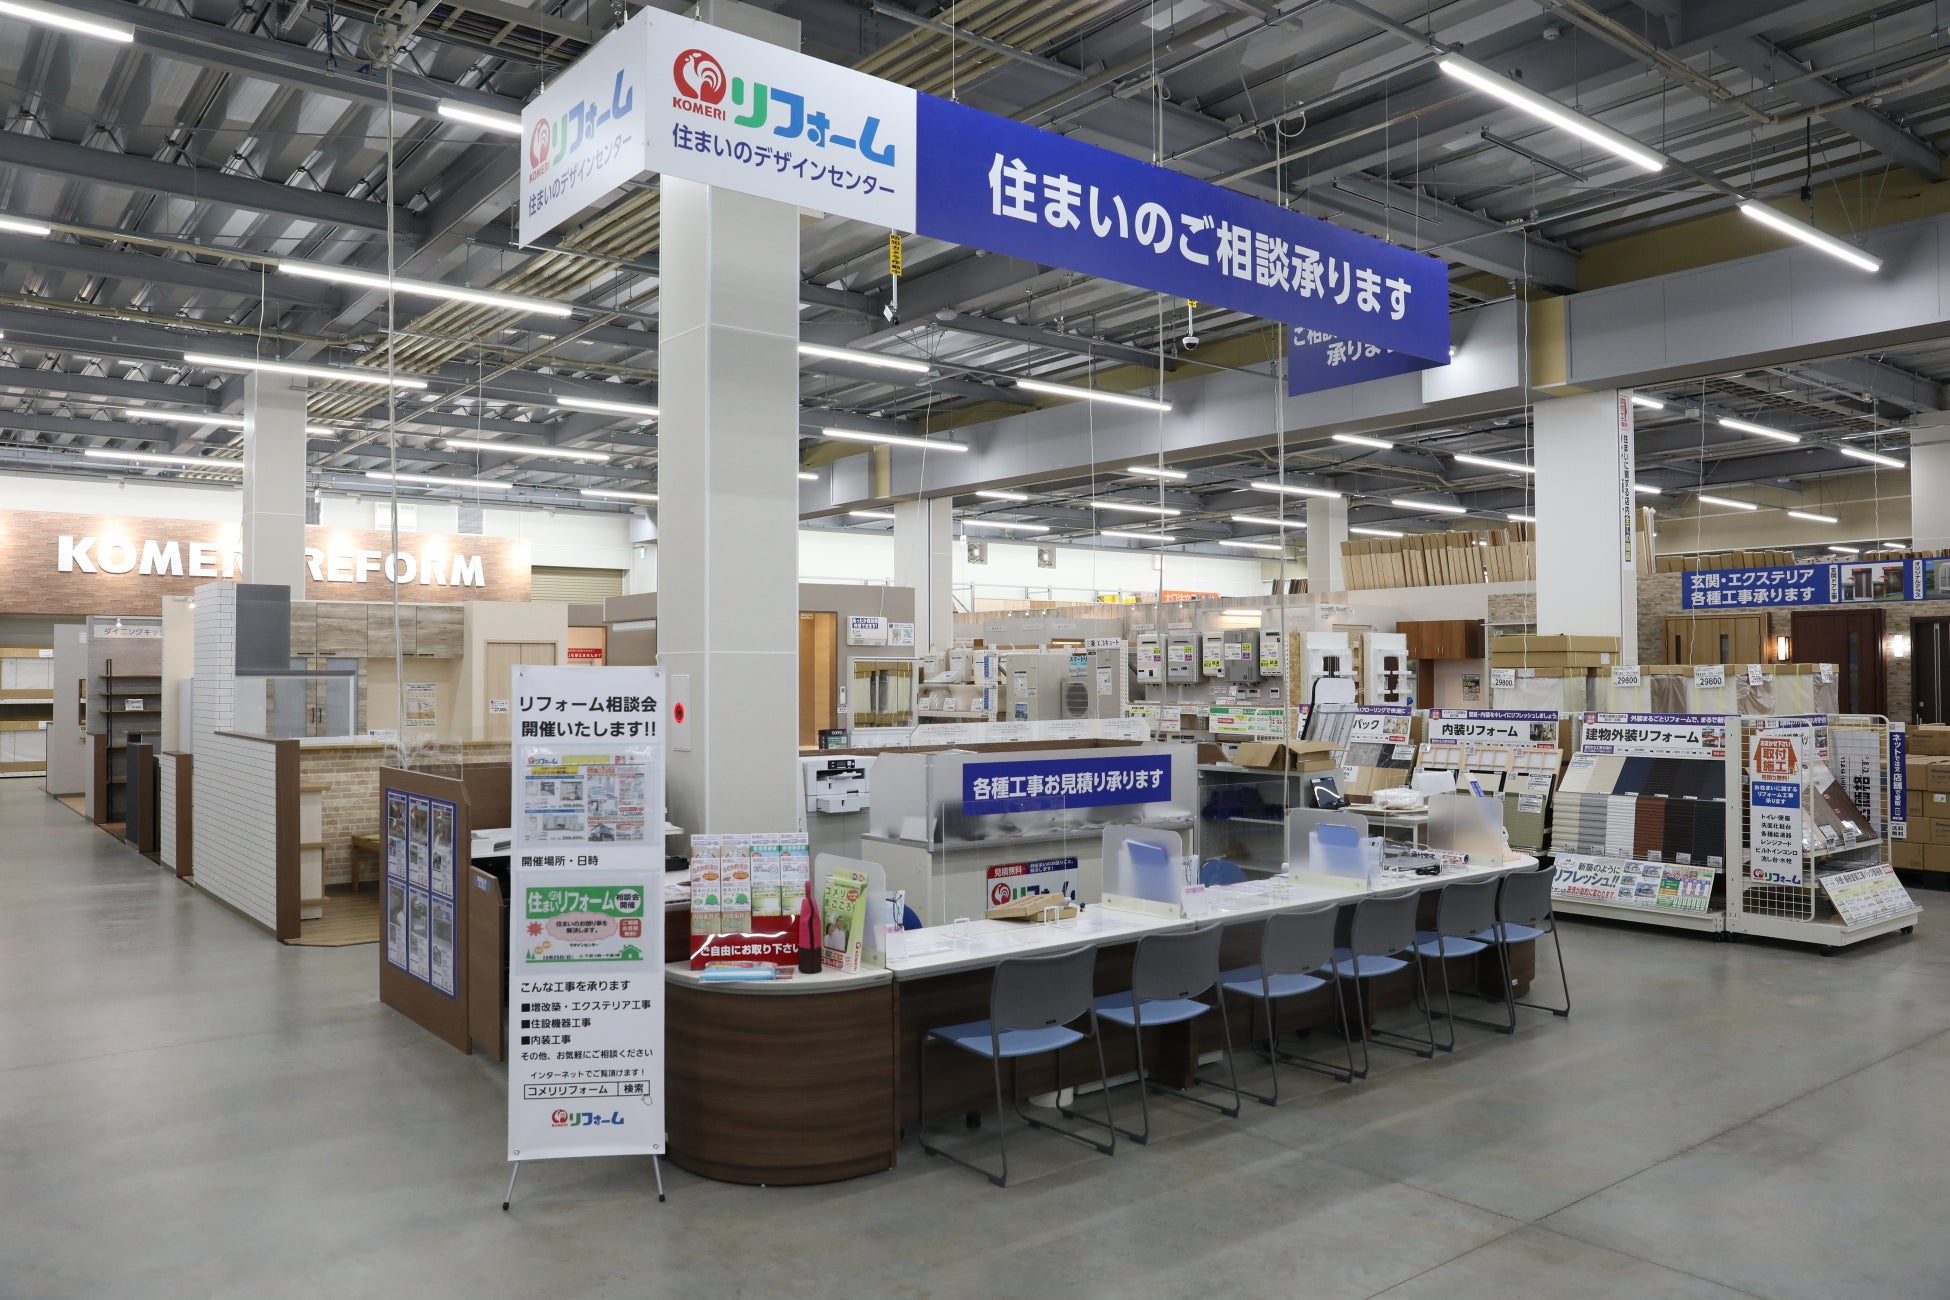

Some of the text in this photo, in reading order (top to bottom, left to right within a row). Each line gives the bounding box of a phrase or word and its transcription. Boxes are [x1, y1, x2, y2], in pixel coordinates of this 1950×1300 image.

[672, 97, 726, 121] KOMERI
[551, 68, 633, 166] リフォーム
[732, 76, 896, 168] リフォーム
[672, 122, 896, 196] 住まいのデザインセンター
[528, 134, 632, 218] 住まいのデザインセンター
[529, 160, 550, 183] KOMERI
[988, 152, 1412, 321] 住まいのご相談承ります
[1690, 569, 1815, 589] 玄関・エクステリア
[1690, 587, 1815, 606] 各種工事承ります
[1700, 677, 1722, 686] 29800
[520, 696, 657, 713] リフォーム相談会
[521, 720, 656, 737] 開催いたします!!
[1353, 718, 1380, 730] パック
[1442, 723, 1518, 737] 内装リフォーム
[1585, 728, 1700, 743] 建物外装リフォーム
[1763, 748, 1786, 760] 取付
[1763, 761, 1787, 772] 施工
[973, 768, 1164, 800] 各種工事お見積り承ります
[1754, 784, 1798, 792] お住まいに関する
[1761, 822, 1791, 830] 洗面化粧台
[1760, 839, 1792, 847] レンジフード
[1755, 847, 1798, 856] ビルトインコンロ
[521, 855, 599, 867] 開催場所・日時
[1578, 862, 1621, 874] 新築のように
[1765, 872, 1801, 885] リフォーム
[521, 980, 631, 993] こんな工事を承ります
[531, 1000, 651, 1013] 増改築・エクステリア工事
[531, 1018, 591, 1029] 住設機器工事
[531, 1034, 571, 1045] 内装工事
[521, 1049, 653, 1061] その他、お気軽にご相談ください
[530, 1069, 644, 1079] インターネットでご覧頂けます!
[528, 1085, 608, 1096] コメリリフォーム
[624, 1084, 644, 1094] 検索
[569, 1111, 625, 1127] リフォーム
